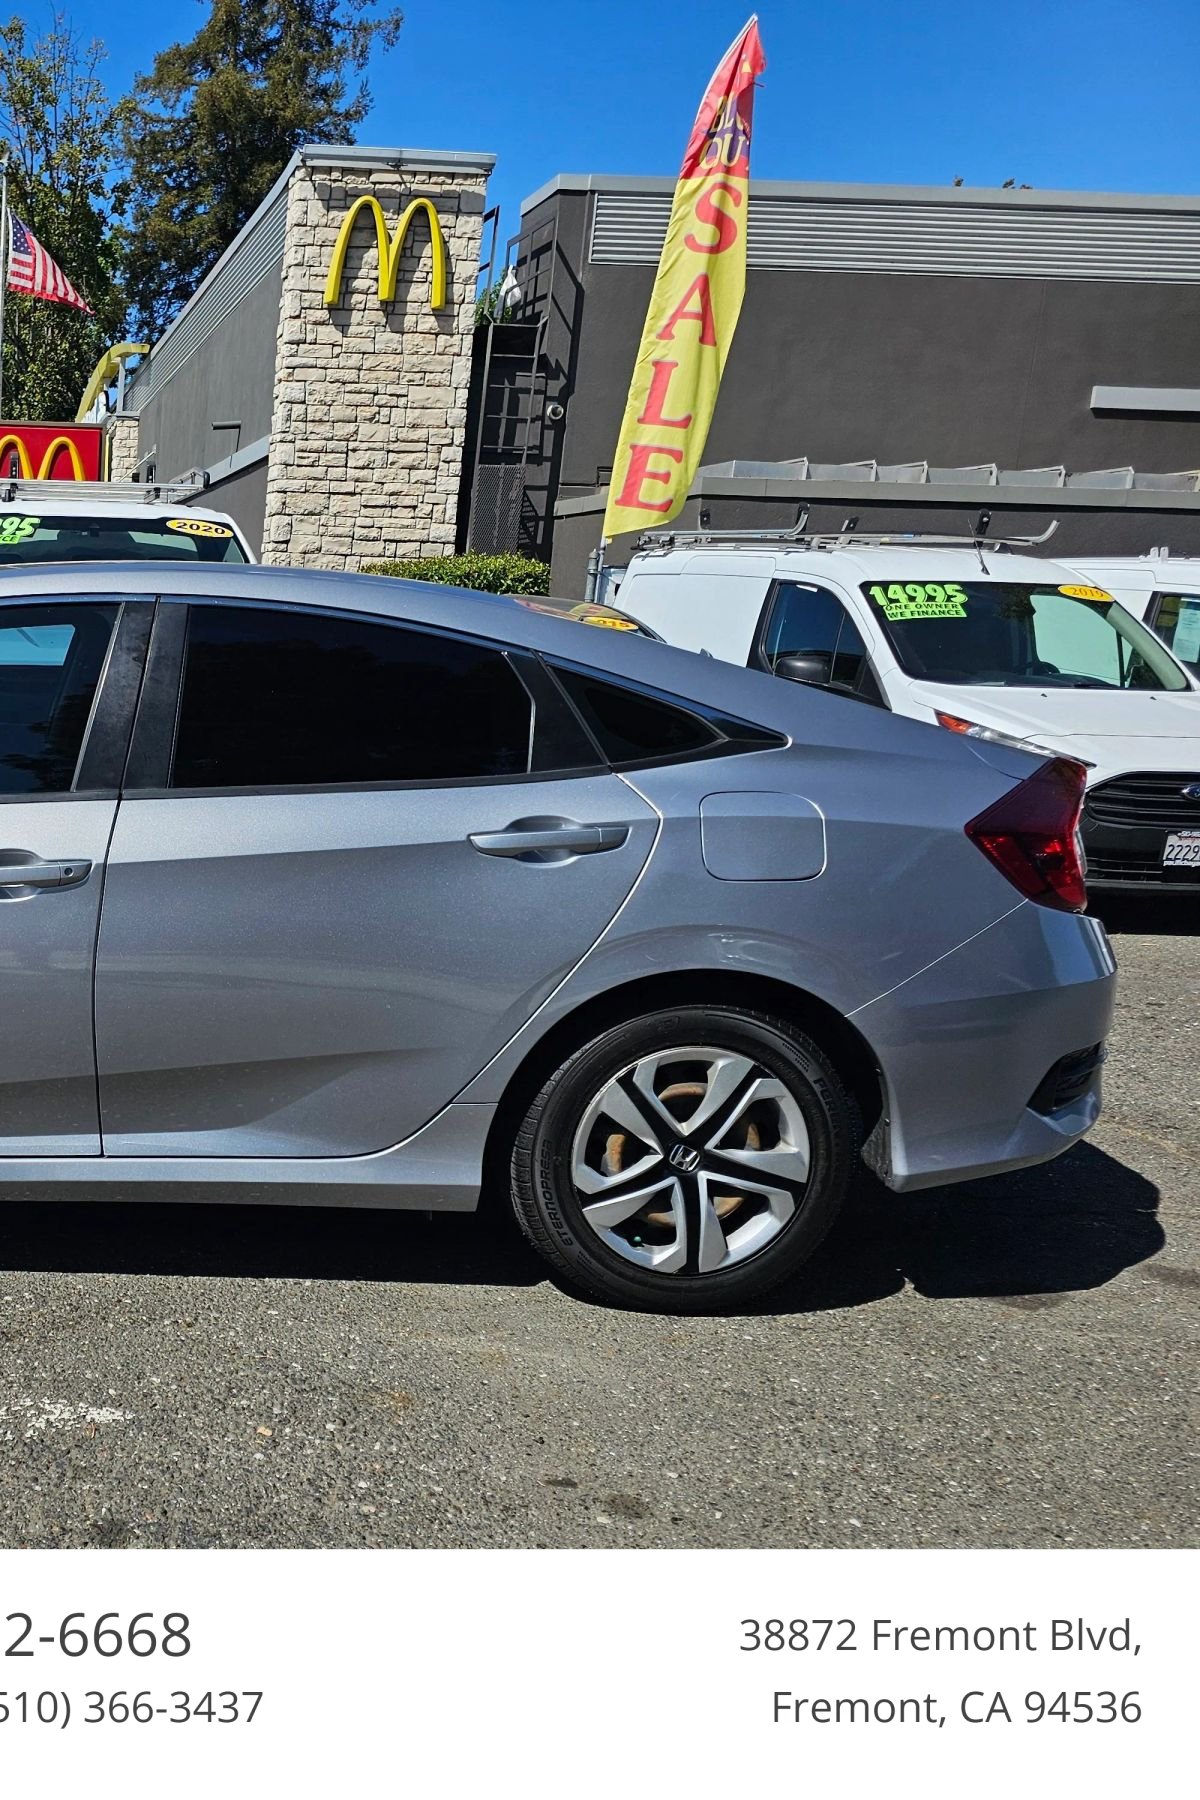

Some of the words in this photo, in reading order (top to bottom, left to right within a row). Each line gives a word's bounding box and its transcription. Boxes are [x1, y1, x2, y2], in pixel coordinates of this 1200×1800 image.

[699, 133, 749, 170] OU
[615, 181, 742, 513] SALE
[175, 521, 226, 535] 2020
[868, 583, 969, 606] 14995
[885, 603, 912, 612] ONE
[887, 611, 907, 619] WE
[910, 609, 962, 617] FINANCE
[1165, 843, 1200, 862] 2229
